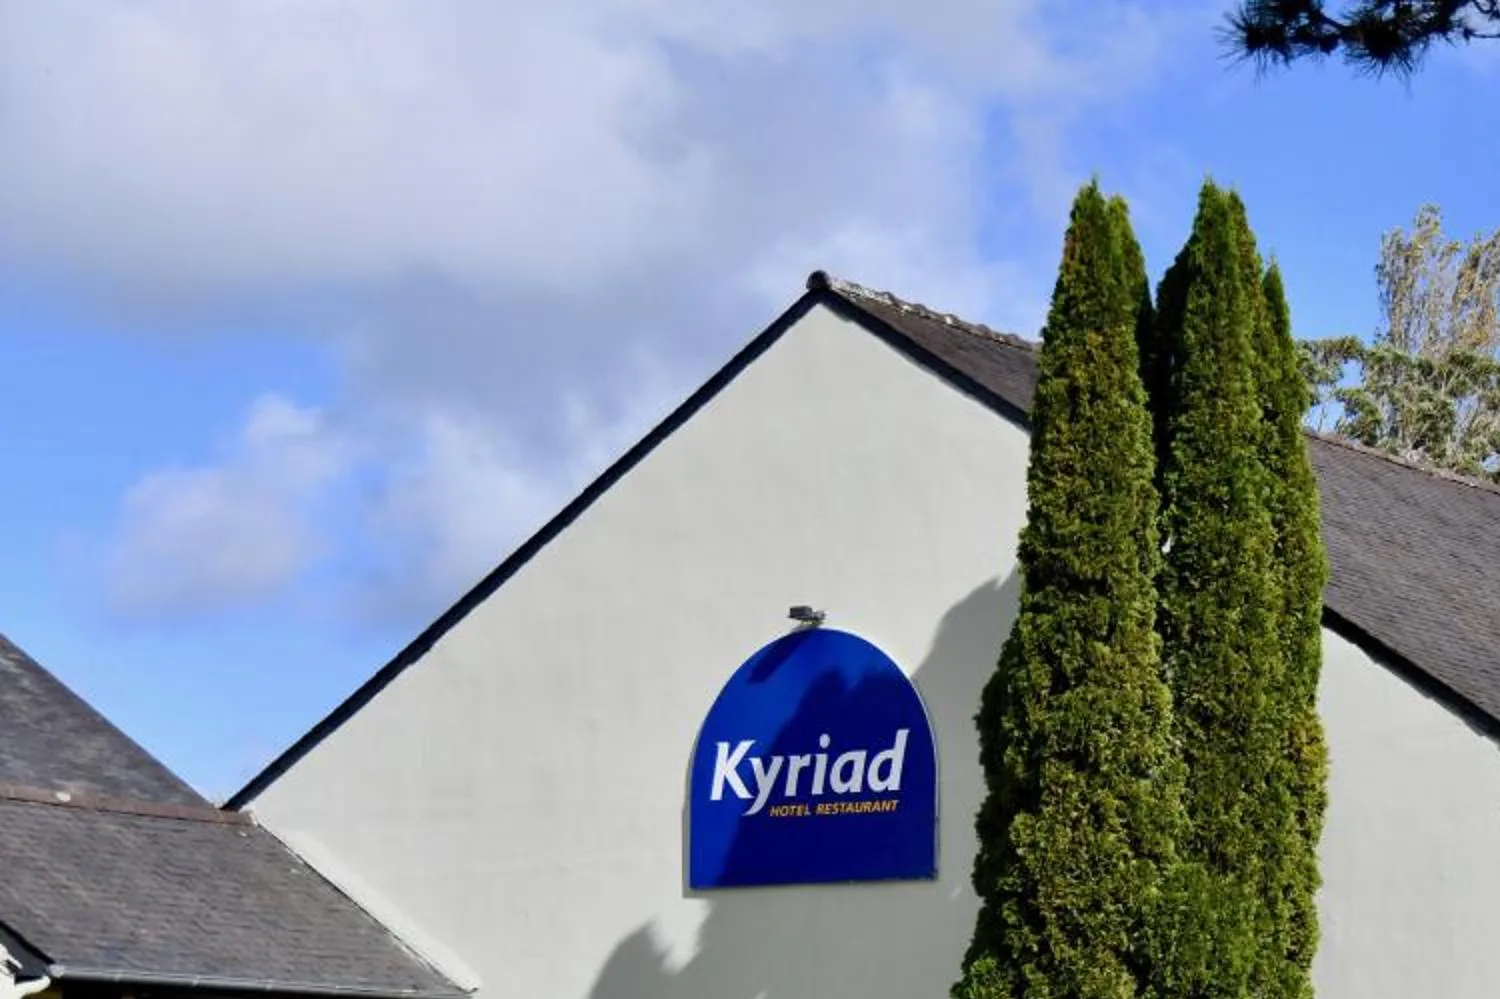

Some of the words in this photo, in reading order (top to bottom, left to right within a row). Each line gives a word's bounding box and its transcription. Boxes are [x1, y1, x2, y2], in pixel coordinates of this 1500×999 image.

[710, 728, 910, 816] Kyriad
[769, 803, 811, 817] HOTEL
[815, 800, 899, 815] RESTAURANT
